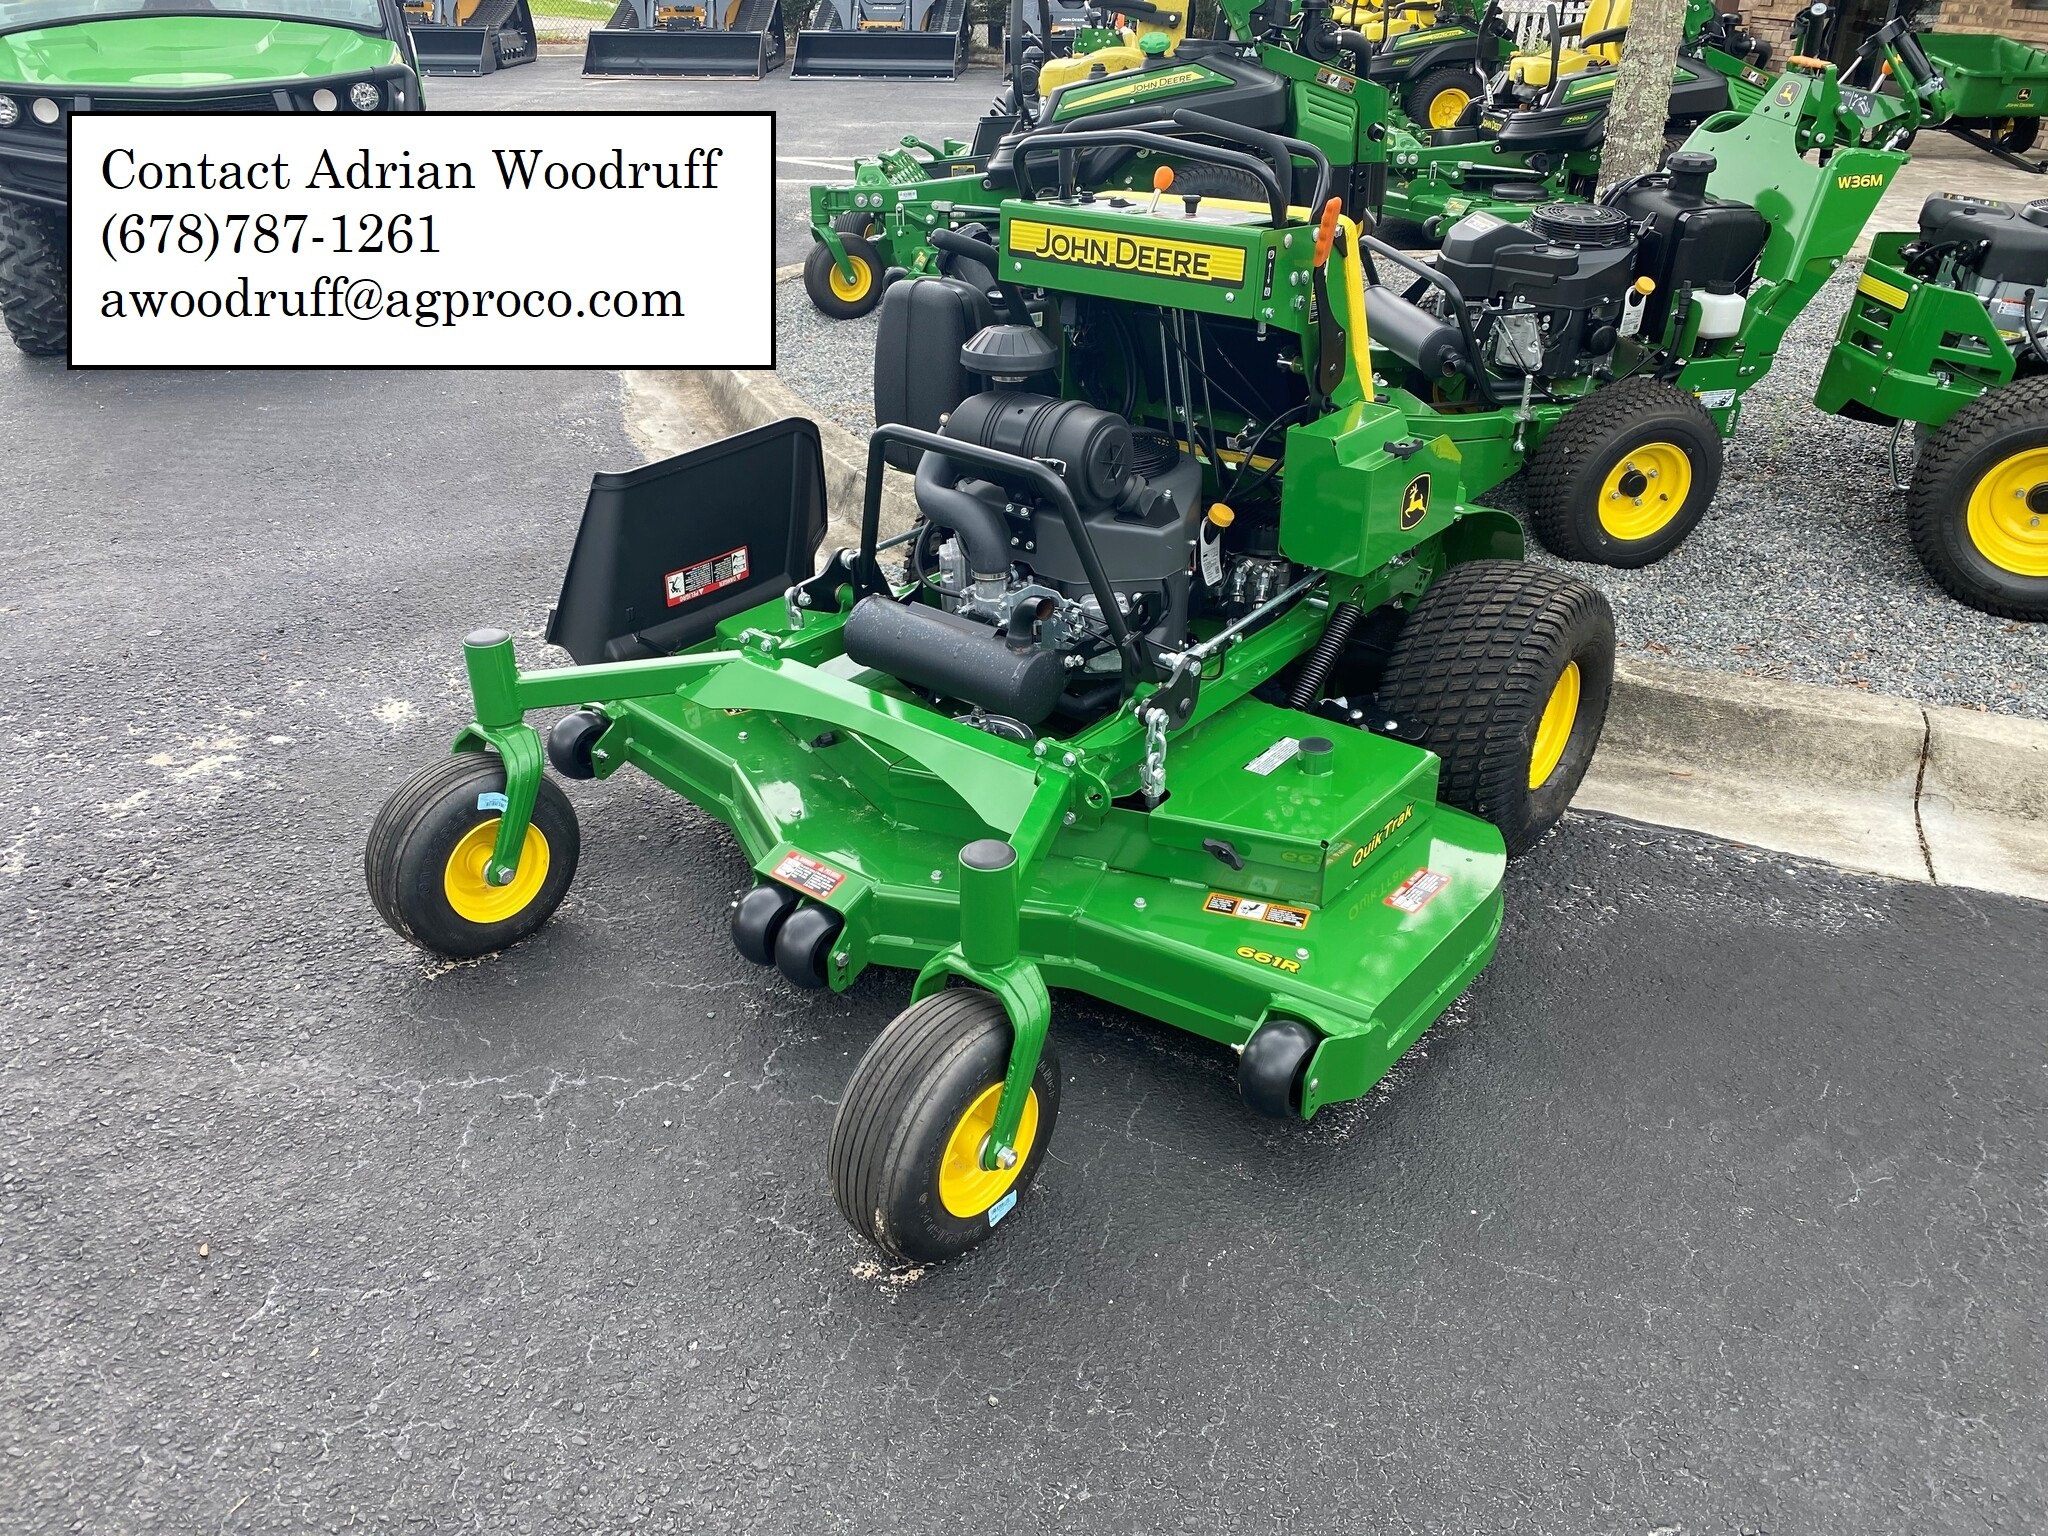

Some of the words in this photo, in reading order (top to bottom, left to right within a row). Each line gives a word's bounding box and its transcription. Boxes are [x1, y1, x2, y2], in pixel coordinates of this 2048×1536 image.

[1131, 81, 1158, 94] JOHN
[1159, 74, 1192, 87] DEERE
[1838, 173, 1883, 189] W36M
[1036, 228, 1110, 265] JOHN
[1115, 237, 1212, 280] DEERE
[1236, 946, 1301, 975] 661R
